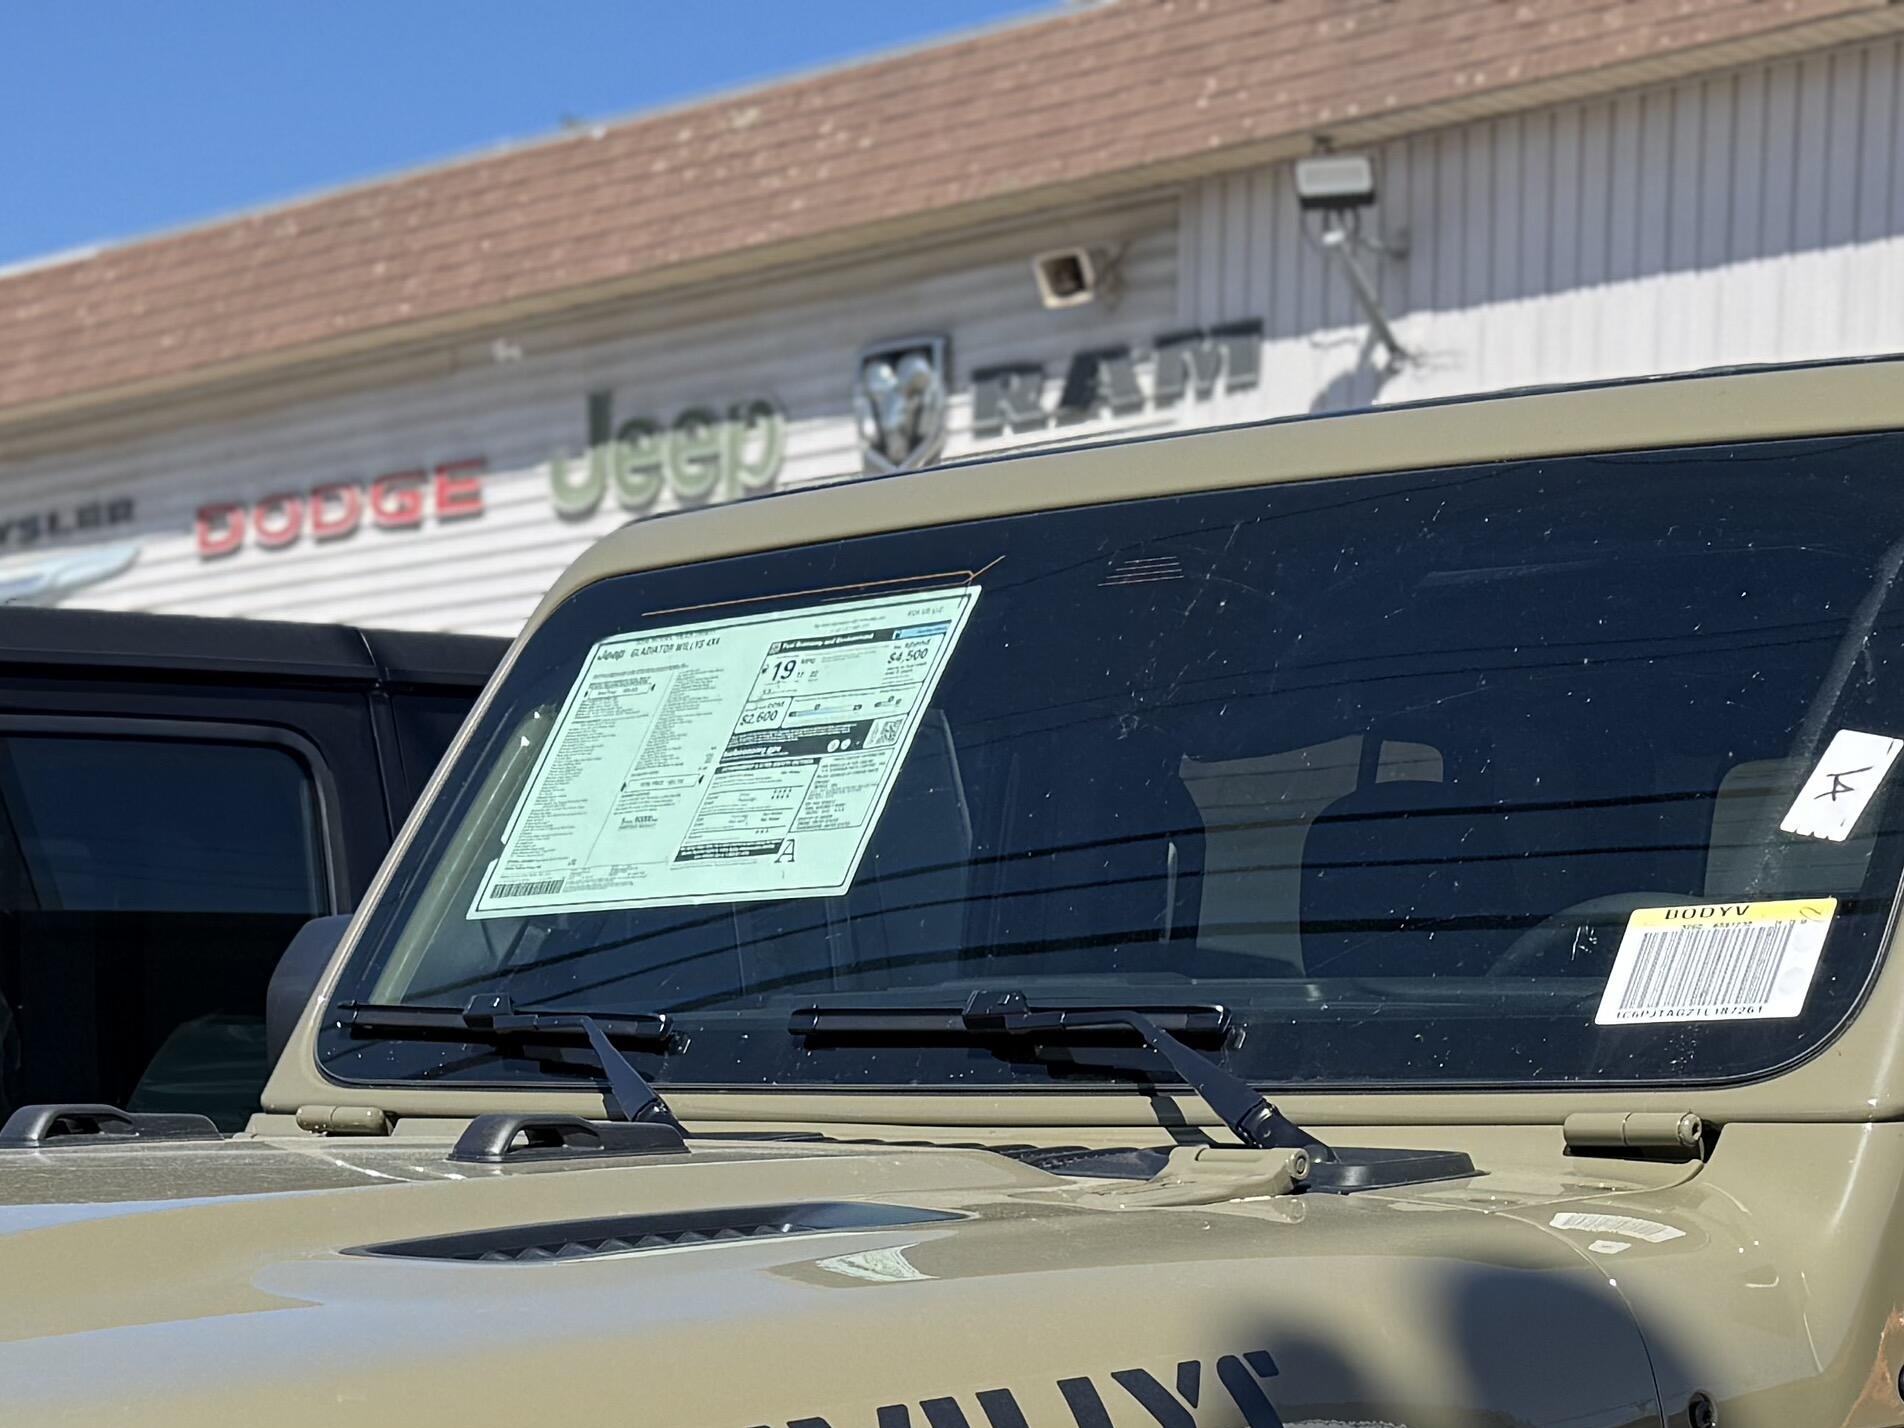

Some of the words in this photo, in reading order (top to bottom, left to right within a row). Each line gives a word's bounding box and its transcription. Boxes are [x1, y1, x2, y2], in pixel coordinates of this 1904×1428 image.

[972, 322, 1263, 440] RAM
[549, 388, 788, 523] Jeep
[195, 457, 487, 560] DODGE
[887, 648, 930, 664] $4,500
[771, 659, 797, 682] 19
[739, 709, 779, 726] $2,600
[1664, 905, 1751, 920] BODYV
